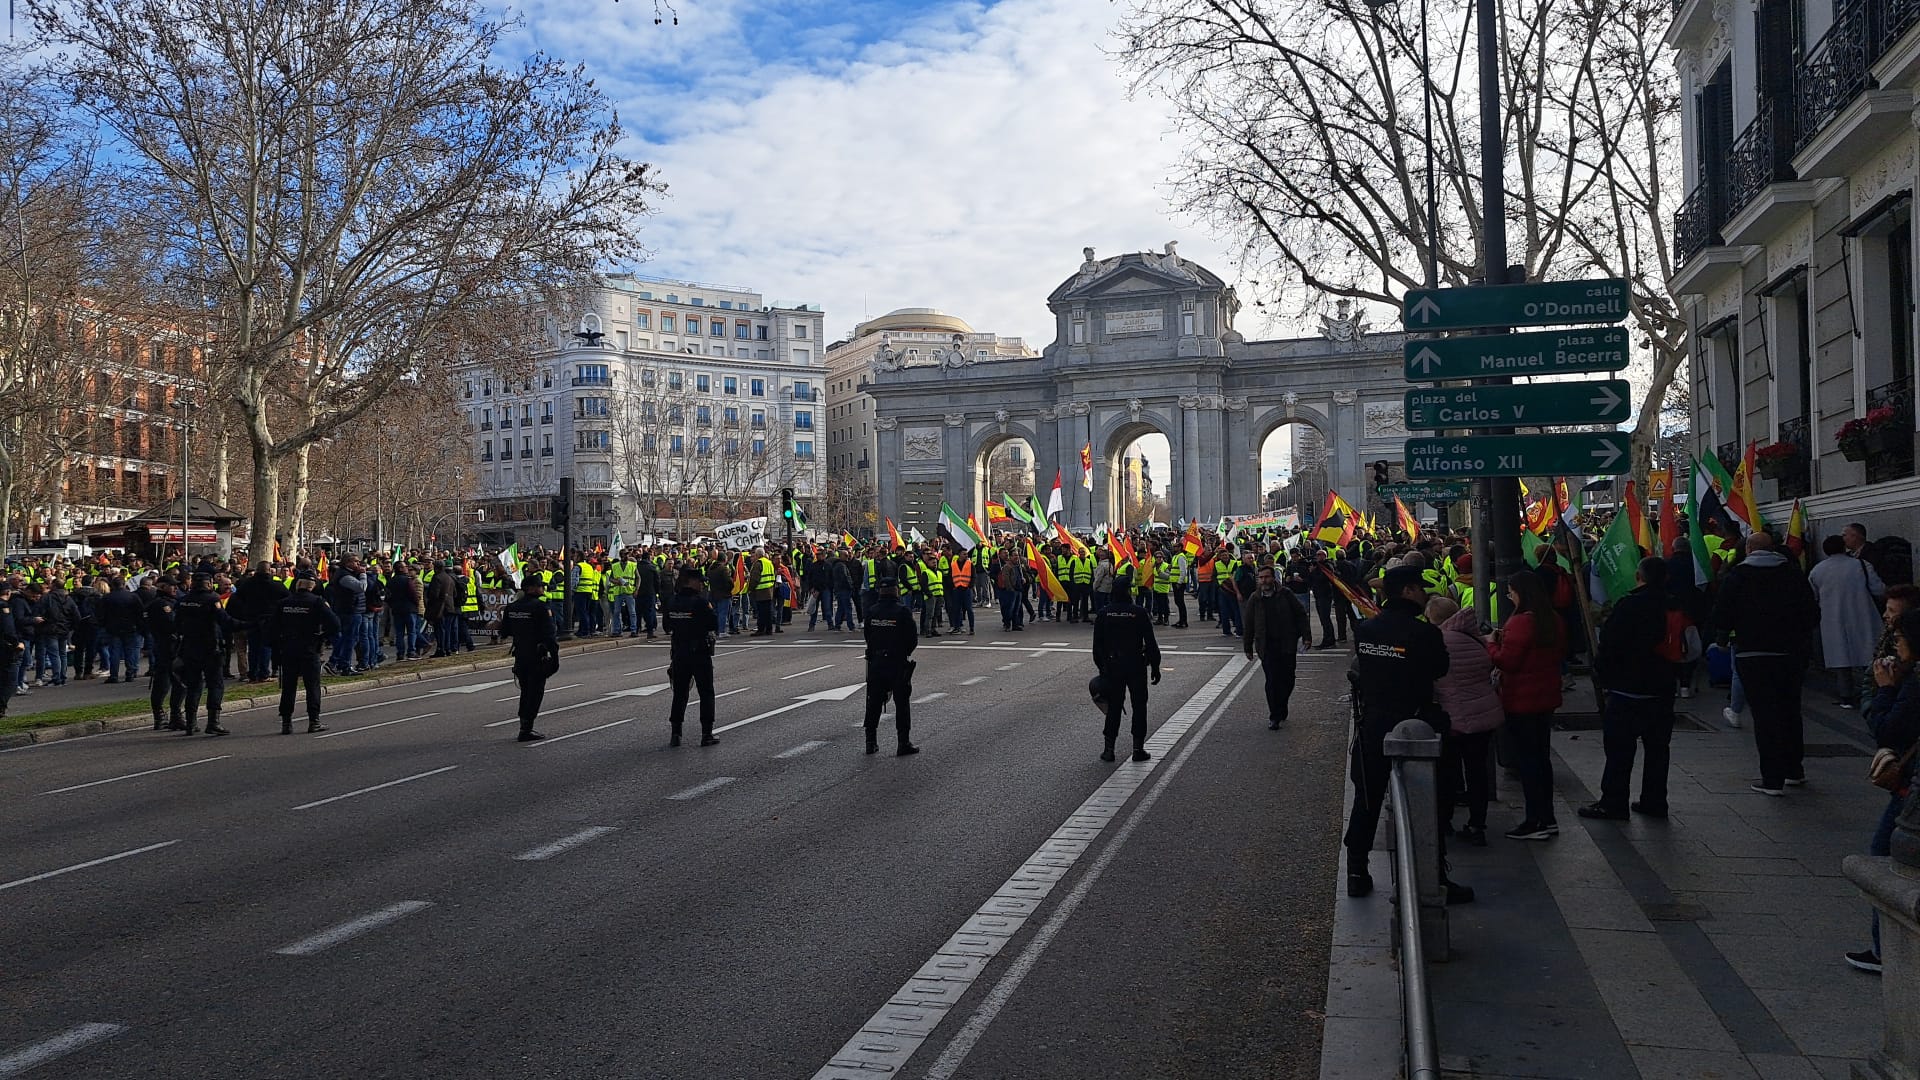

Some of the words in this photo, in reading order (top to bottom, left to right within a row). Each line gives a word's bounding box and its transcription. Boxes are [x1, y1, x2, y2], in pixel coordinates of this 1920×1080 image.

[1586, 286, 1621, 297] calle
[1523, 300, 1621, 317] O'Donnell
[1558, 335, 1595, 348] plaza
[1604, 333, 1621, 343] de
[1480, 352, 1545, 369] Manuel
[1555, 350, 1622, 365] Becerra
[1411, 394, 1446, 406] plaza
[1456, 391, 1478, 402] del
[1411, 409, 1427, 423] E.
[1439, 407, 1500, 422] Carlos
[1512, 405, 1525, 419] V
[1411, 444, 1444, 455] calle
[1451, 444, 1468, 454] de
[1412, 457, 1485, 471] Alfonso
[1497, 455, 1523, 469] XII
[717, 525, 748, 540] QUERO
[481, 593, 497, 605] PO
[1359, 642, 1395, 652] POLICIA
[1359, 648, 1406, 659] NACIONAL
